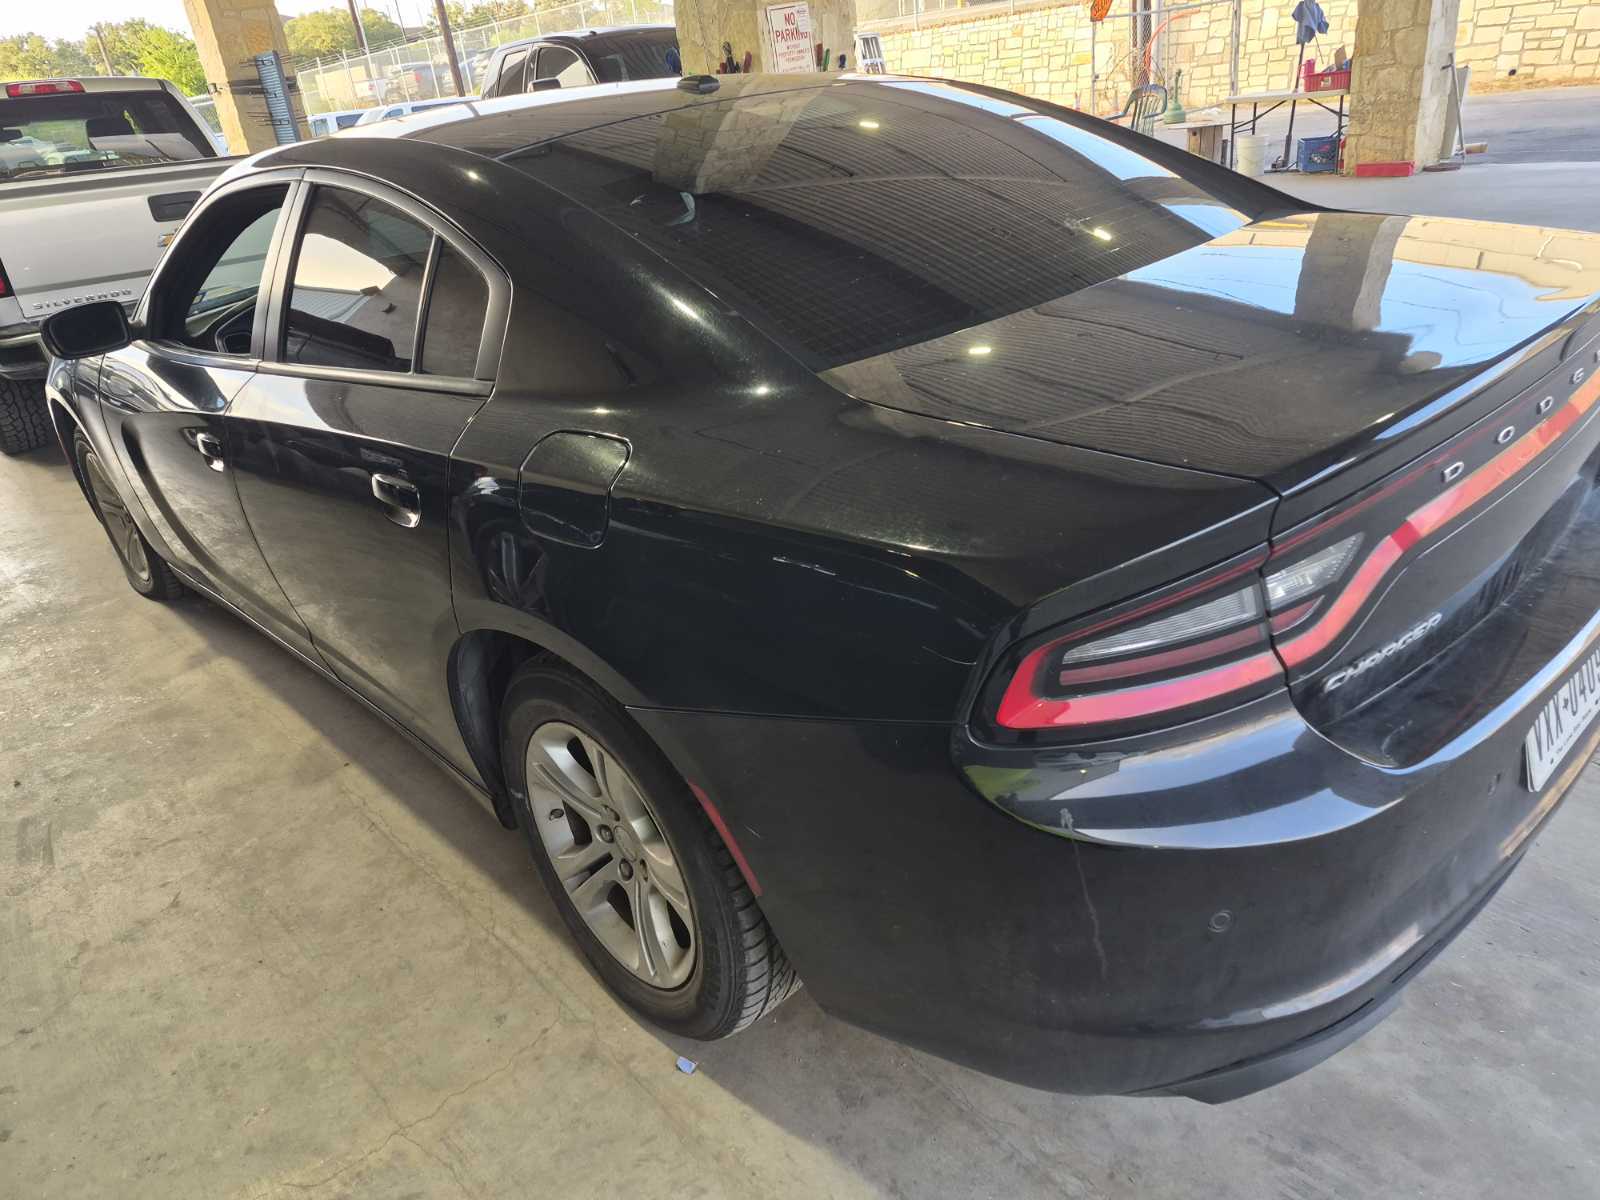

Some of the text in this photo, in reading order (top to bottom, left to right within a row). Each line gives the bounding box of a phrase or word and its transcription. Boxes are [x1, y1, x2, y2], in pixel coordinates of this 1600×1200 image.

[784, 11, 796, 26] NO
[33, 287, 132, 310] SILVERADO
[1324, 612, 1442, 693] CHARGER
